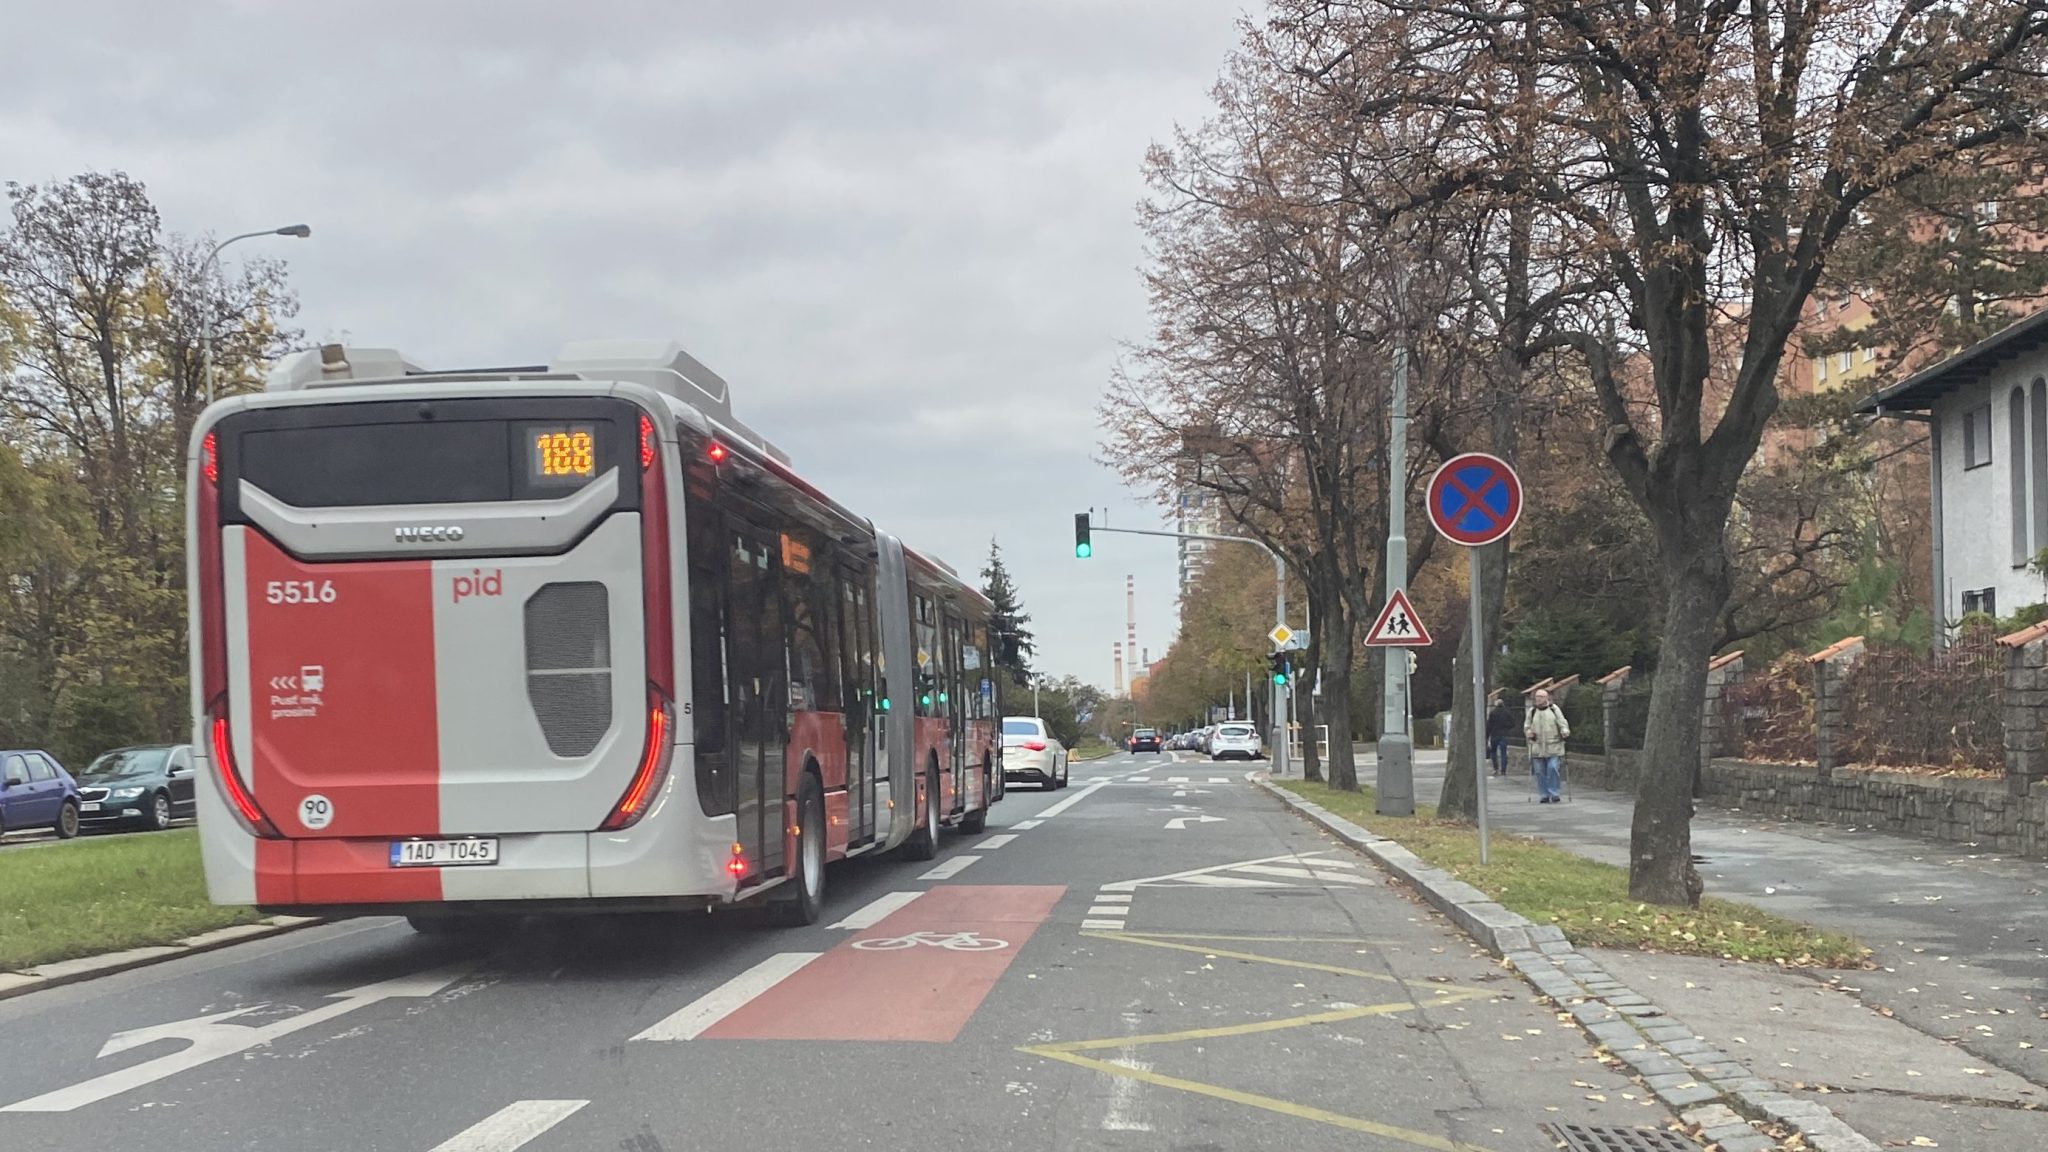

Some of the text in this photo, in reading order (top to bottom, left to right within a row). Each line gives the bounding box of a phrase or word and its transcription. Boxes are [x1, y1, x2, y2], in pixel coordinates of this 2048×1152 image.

[537, 432, 592, 475] 188
[395, 526, 464, 543] IVECO
[266, 580, 336, 604] 5516
[452, 568, 502, 603] pid
[684, 702, 691, 715] 5
[305, 800, 328, 815] 90
[405, 842, 435, 860] 1AD
